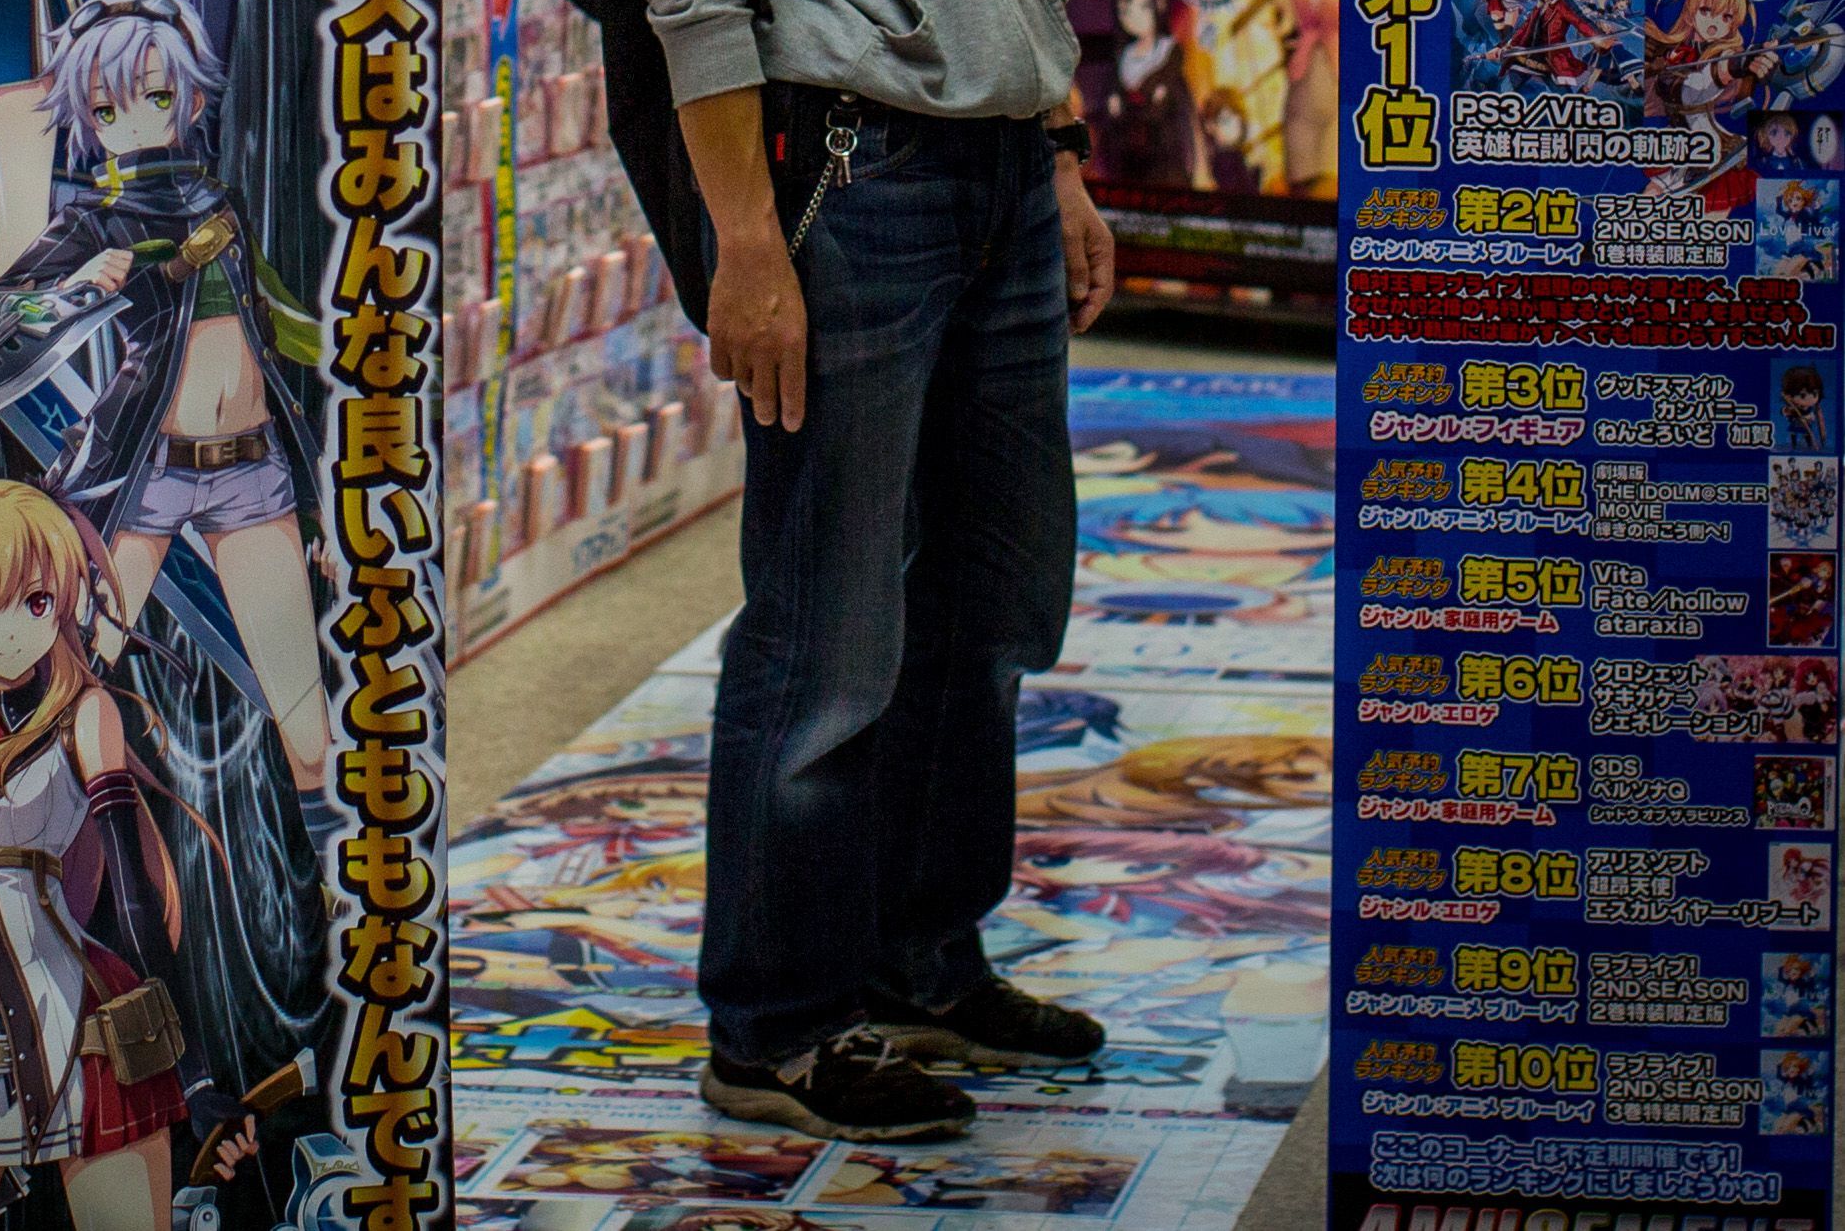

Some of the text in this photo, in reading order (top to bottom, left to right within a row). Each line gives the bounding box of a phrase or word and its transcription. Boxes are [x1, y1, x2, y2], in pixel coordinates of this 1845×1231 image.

[1453, 129, 1717, 165] 英雄伝説 閃の軌跡2
[1455, 185, 1580, 237] 第2位
[1596, 195, 1703, 217] ラブライブ!
[1357, 209, 1447, 229] ランキング
[1595, 220, 1753, 243] 2ND SEASON
[1492, 241, 1583, 265] ブルーレイ
[1363, 384, 1452, 404] ランキング
[1462, 361, 1585, 411] 第3位
[1596, 374, 1732, 399] グッドスマイル
[1596, 422, 1774, 448] ねんどろいど 加賀
[1361, 480, 1451, 501] ランキング
[1460, 460, 1584, 509] 第4位
[1595, 483, 1768, 503] THE IDOLM@STER
[1502, 509, 1591, 536] ブルーレイ
[1599, 503, 1663, 521] MOVIE
[1361, 576, 1450, 598] ランキング
[1459, 556, 1582, 607] 第5位
[1593, 564, 1648, 587] Vita
[1595, 614, 1703, 637] ataraxia
[1458, 652, 1581, 705] 第6位
[1593, 660, 1707, 685] クロシェット
[1360, 673, 1449, 696] ランキング
[1458, 751, 1580, 803] 第7位
[1592, 757, 1641, 779] 3DS
[1359, 770, 1447, 792] ランキング
[1455, 848, 1580, 899] 第8位
[1587, 850, 1709, 875] アリスソフト
[1357, 870, 1446, 890] ランキング
[1356, 965, 1445, 986] ランキング
[1454, 944, 1578, 996] 第9位
[1589, 954, 1698, 977] ラブライブ!
[1589, 980, 1748, 1003] 2ND SEASON
[1356, 1060, 1445, 1083] ランキング
[1453, 1039, 1600, 1093] 第10位
[1607, 1054, 1716, 1077] ラブライブ!
[1606, 1079, 1763, 1102] 2ND SEASON
